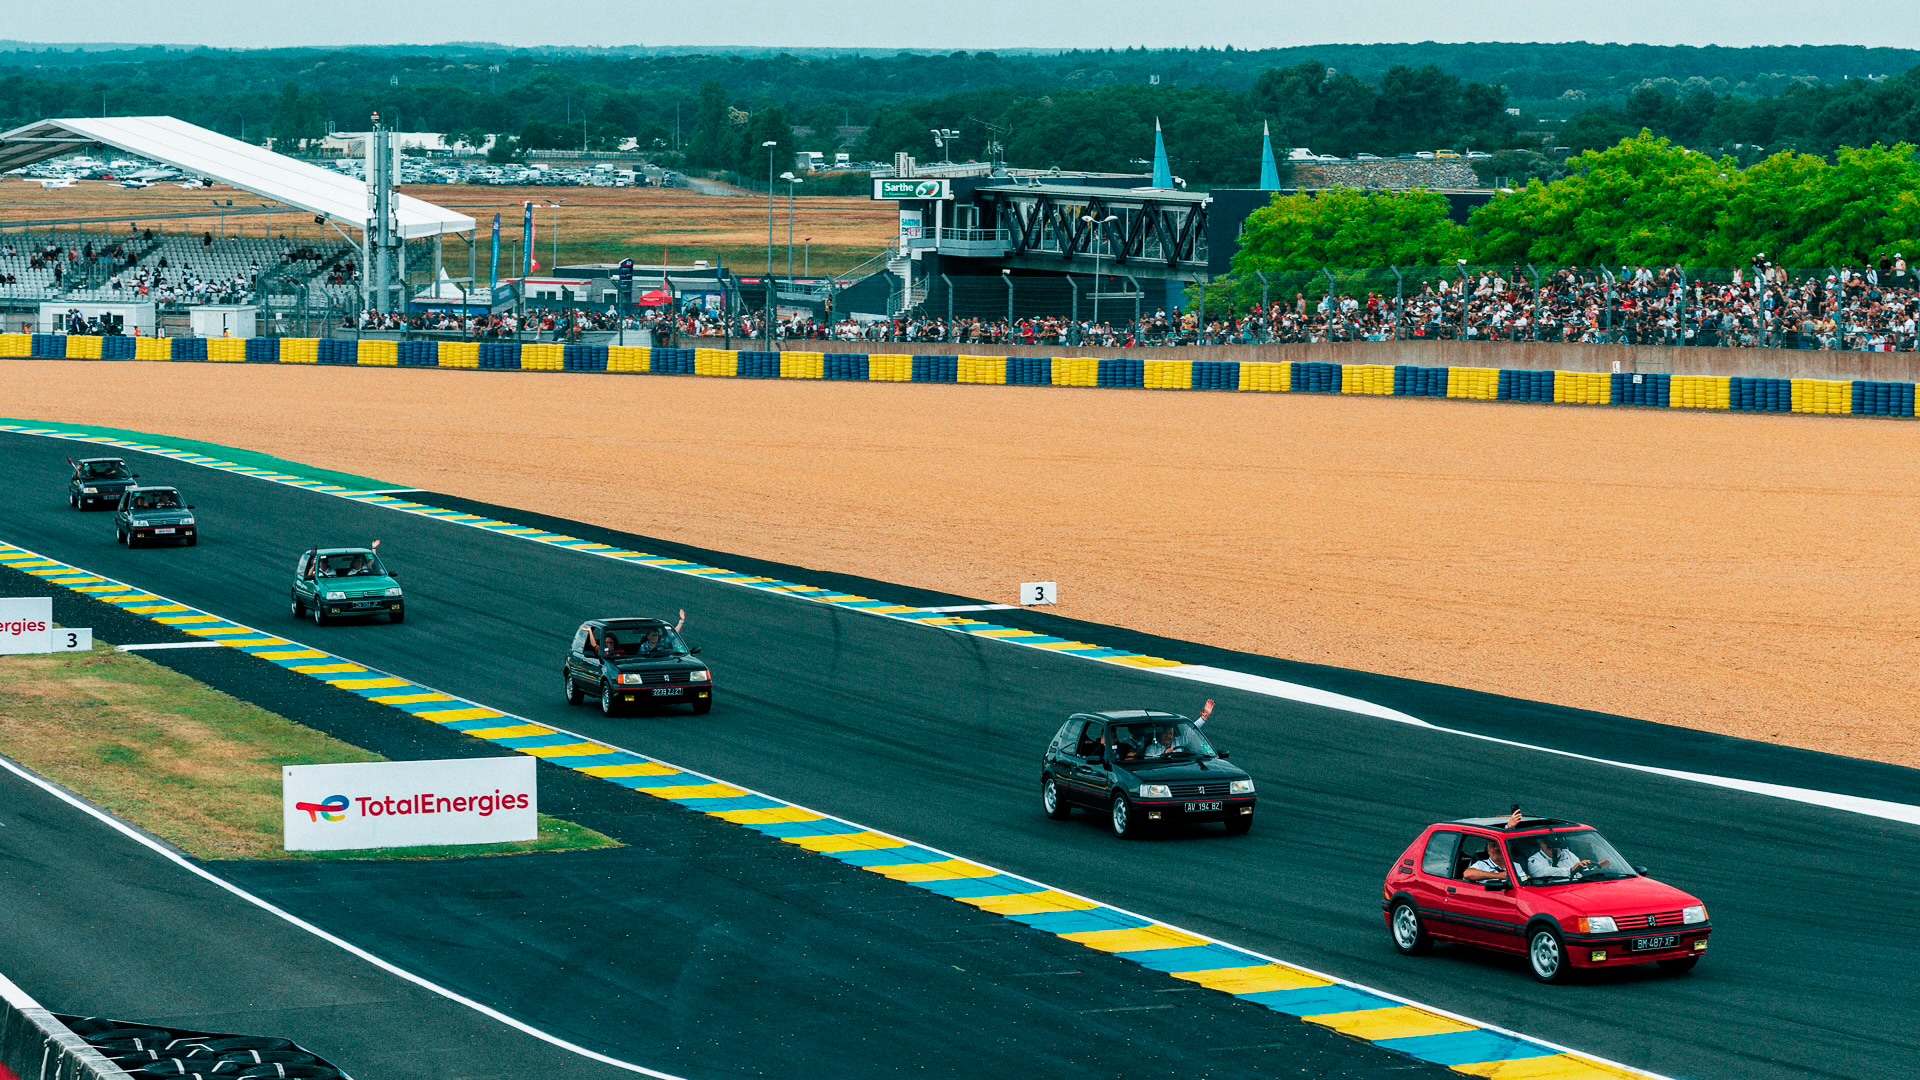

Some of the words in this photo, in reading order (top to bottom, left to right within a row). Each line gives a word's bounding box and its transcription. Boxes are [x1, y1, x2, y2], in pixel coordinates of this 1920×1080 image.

[884, 182, 914, 192] Sarthe
[1035, 586, 1044, 601] 3
[67, 632, 78, 648] 3
[355, 789, 529, 817] TotalEnergies
[1187, 803, 1196, 811] AV
[1199, 802, 1210, 811] 194
